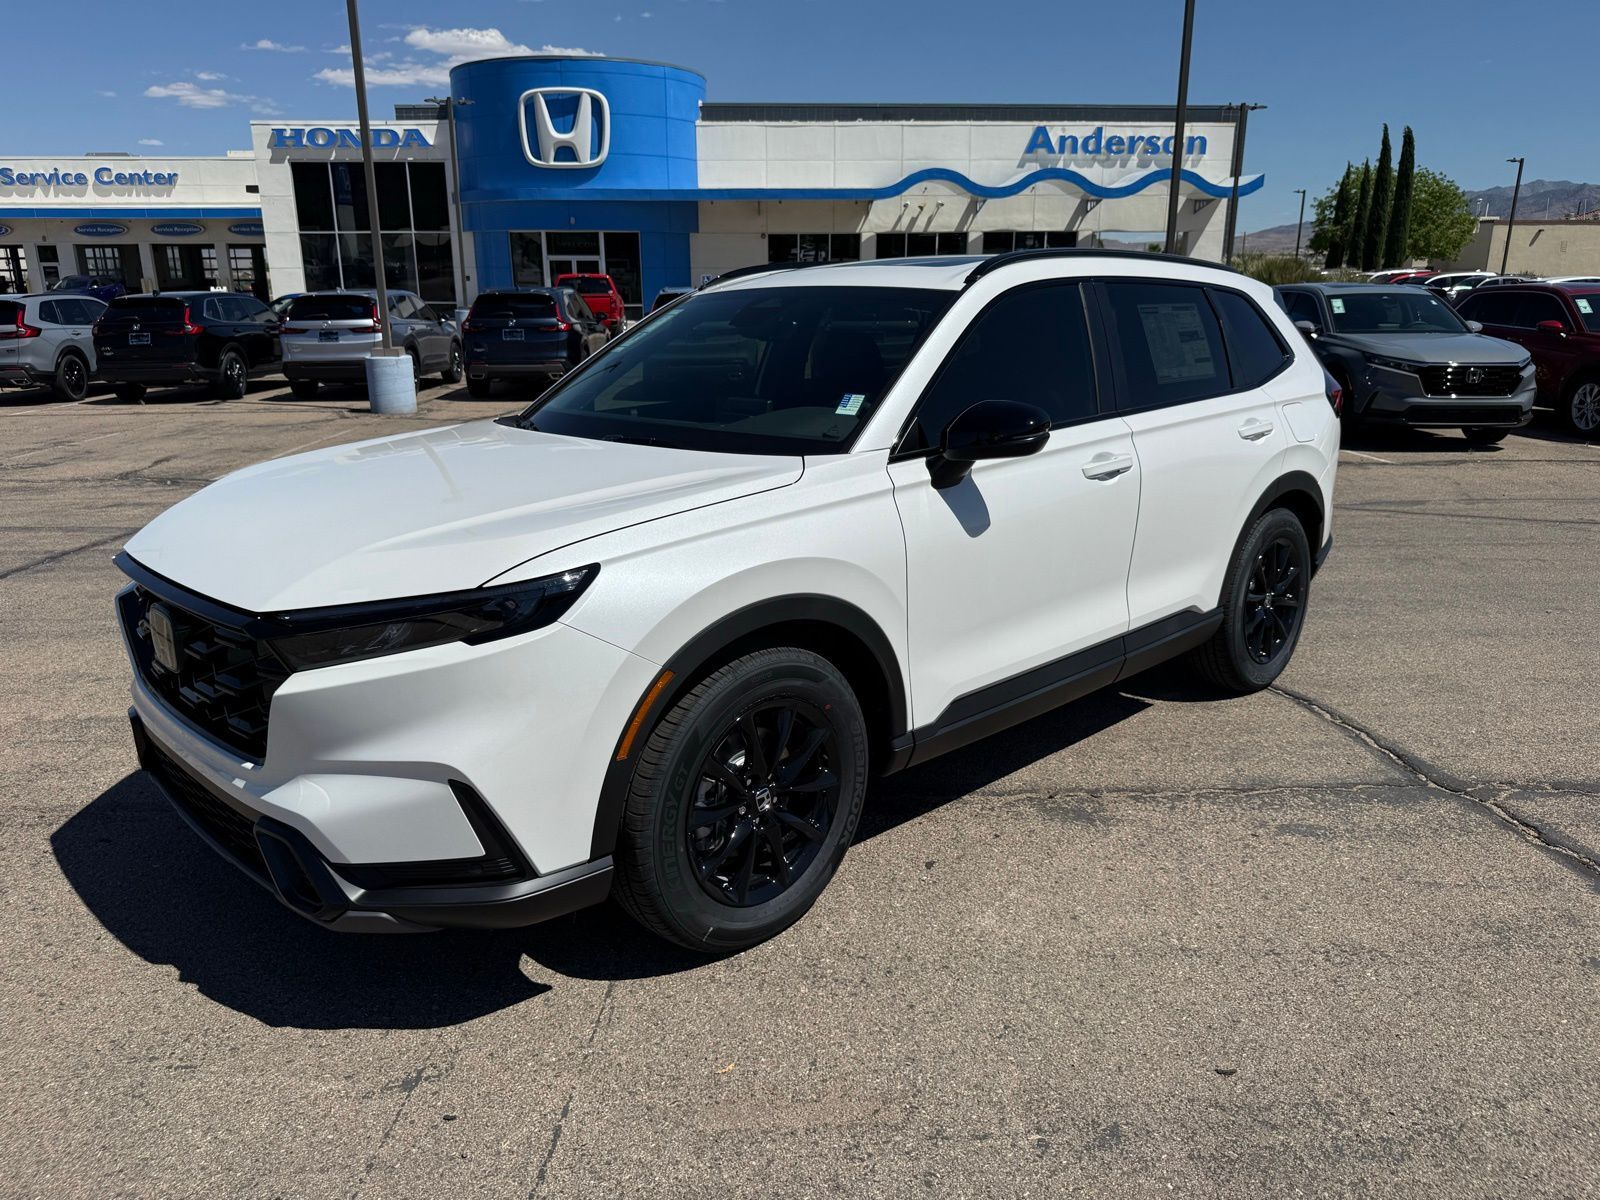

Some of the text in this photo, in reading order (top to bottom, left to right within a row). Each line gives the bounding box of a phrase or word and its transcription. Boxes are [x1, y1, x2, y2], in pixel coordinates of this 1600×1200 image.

[271, 127, 433, 148] HONDA
[1024, 125, 1207, 156] Anderson
[0, 166, 178, 186] Service Center
